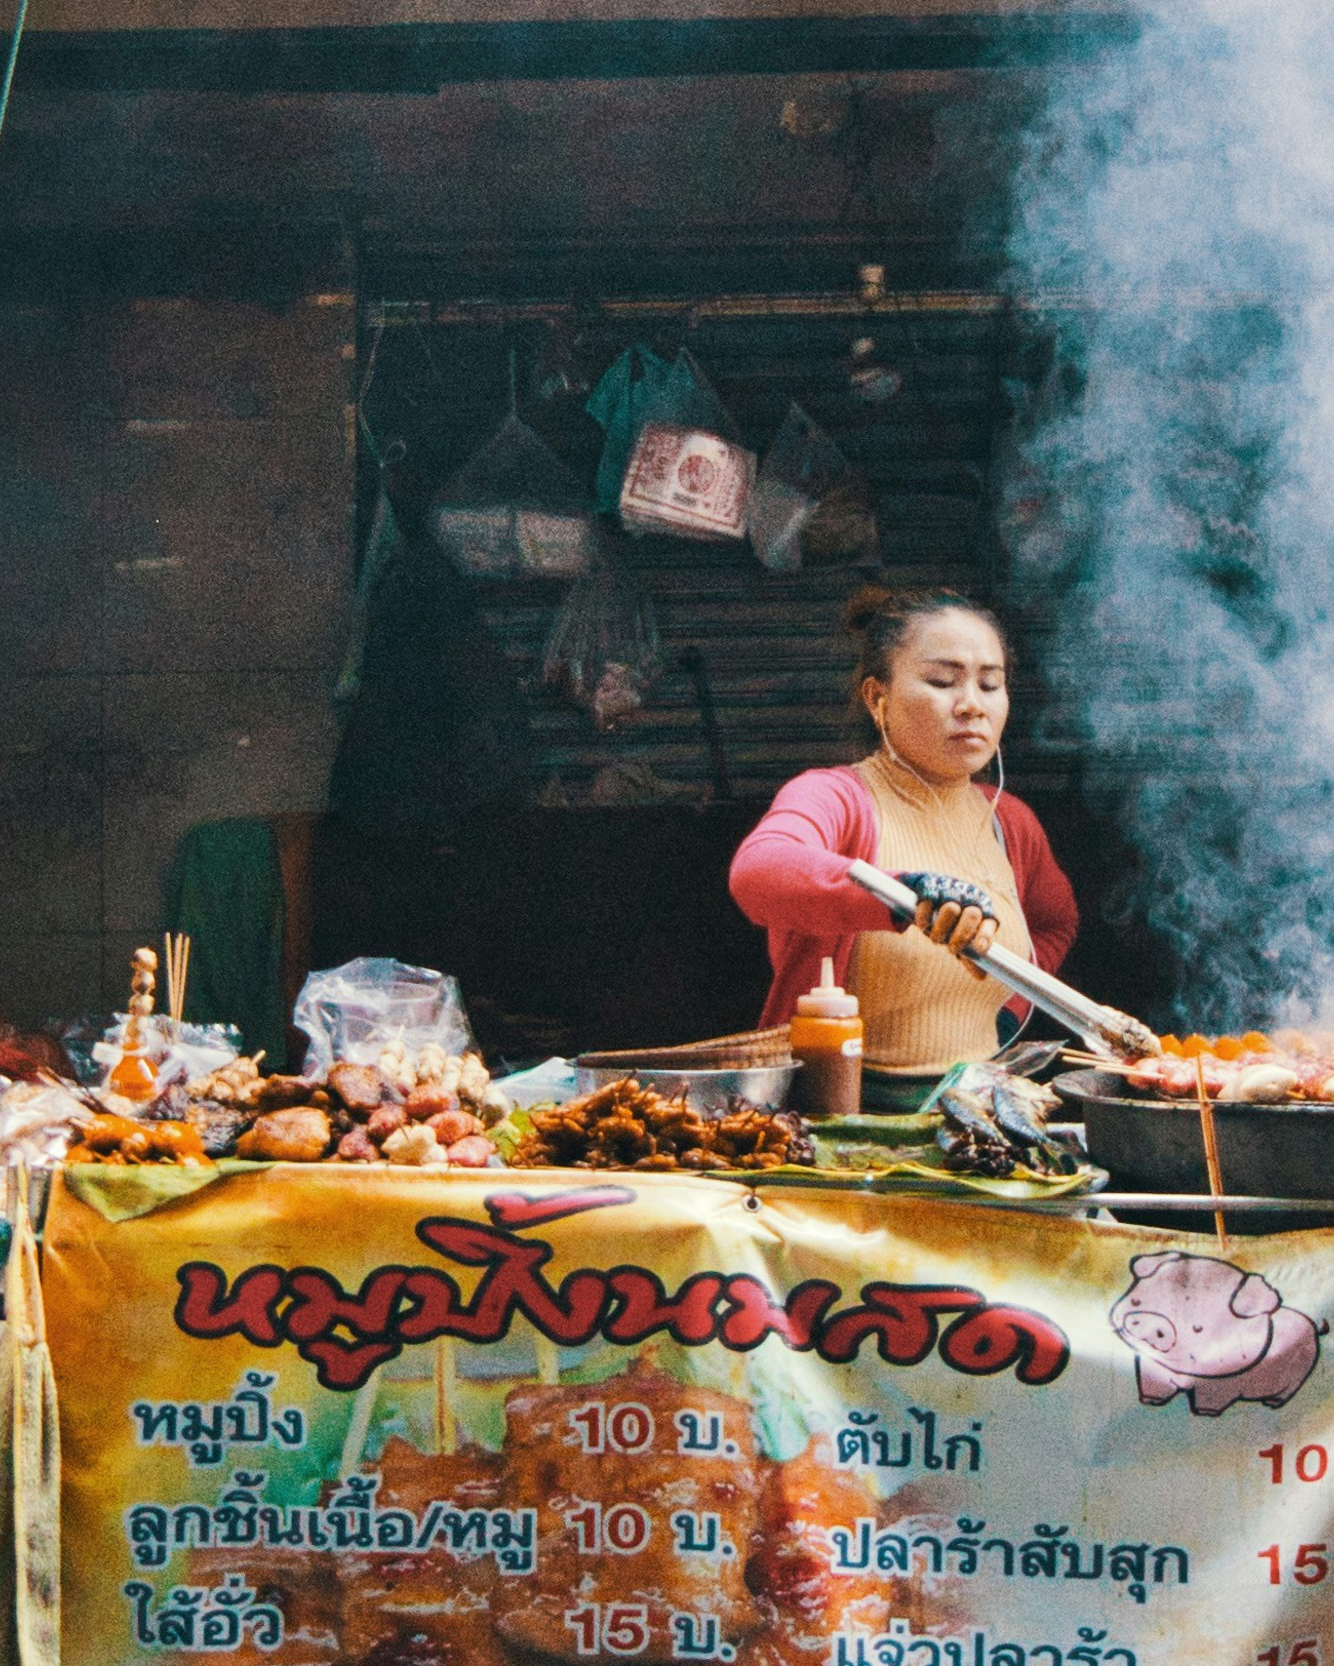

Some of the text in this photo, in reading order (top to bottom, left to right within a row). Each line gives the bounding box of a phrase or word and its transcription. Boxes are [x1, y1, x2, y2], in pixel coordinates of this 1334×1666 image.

[134, 1370, 736, 1464] หมูปิ้ง 10 บ.
[836, 1407, 982, 1472] ตับไก่
[1258, 1443, 1328, 1484] 10
[128, 1470, 733, 1570] ลูกชิ้นเนื้อ/หมู 10 บ.
[831, 1517, 1190, 1603] ปลาร้าสับสุก
[1257, 1543, 1329, 1585] 15
[124, 1576, 732, 1656] ใส้อั่ว 15 บ.
